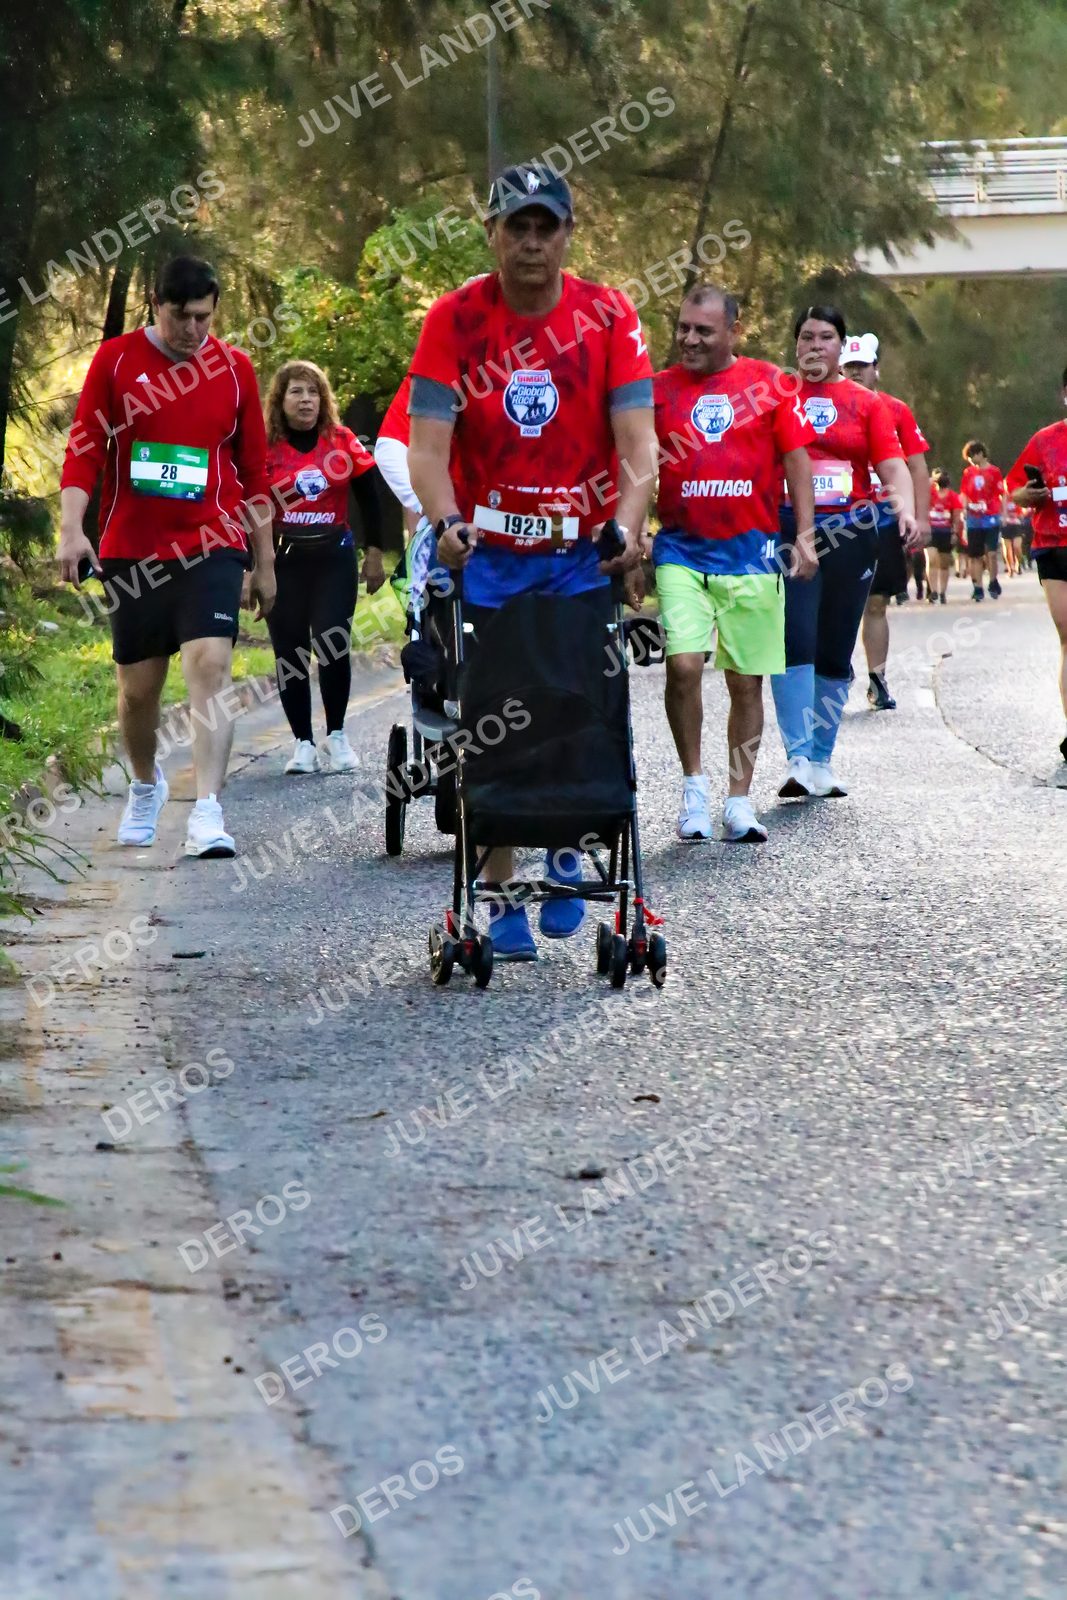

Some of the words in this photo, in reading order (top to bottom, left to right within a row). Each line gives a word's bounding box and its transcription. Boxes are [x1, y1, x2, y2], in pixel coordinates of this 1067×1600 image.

[517, 386, 547, 397] Global
[512, 395, 535, 405] Race
[160, 464, 178, 480] 28
[681, 479, 753, 497] SANTIAGO
[282, 511, 336, 525] SANTIAGO
[503, 513, 547, 537] 1929
